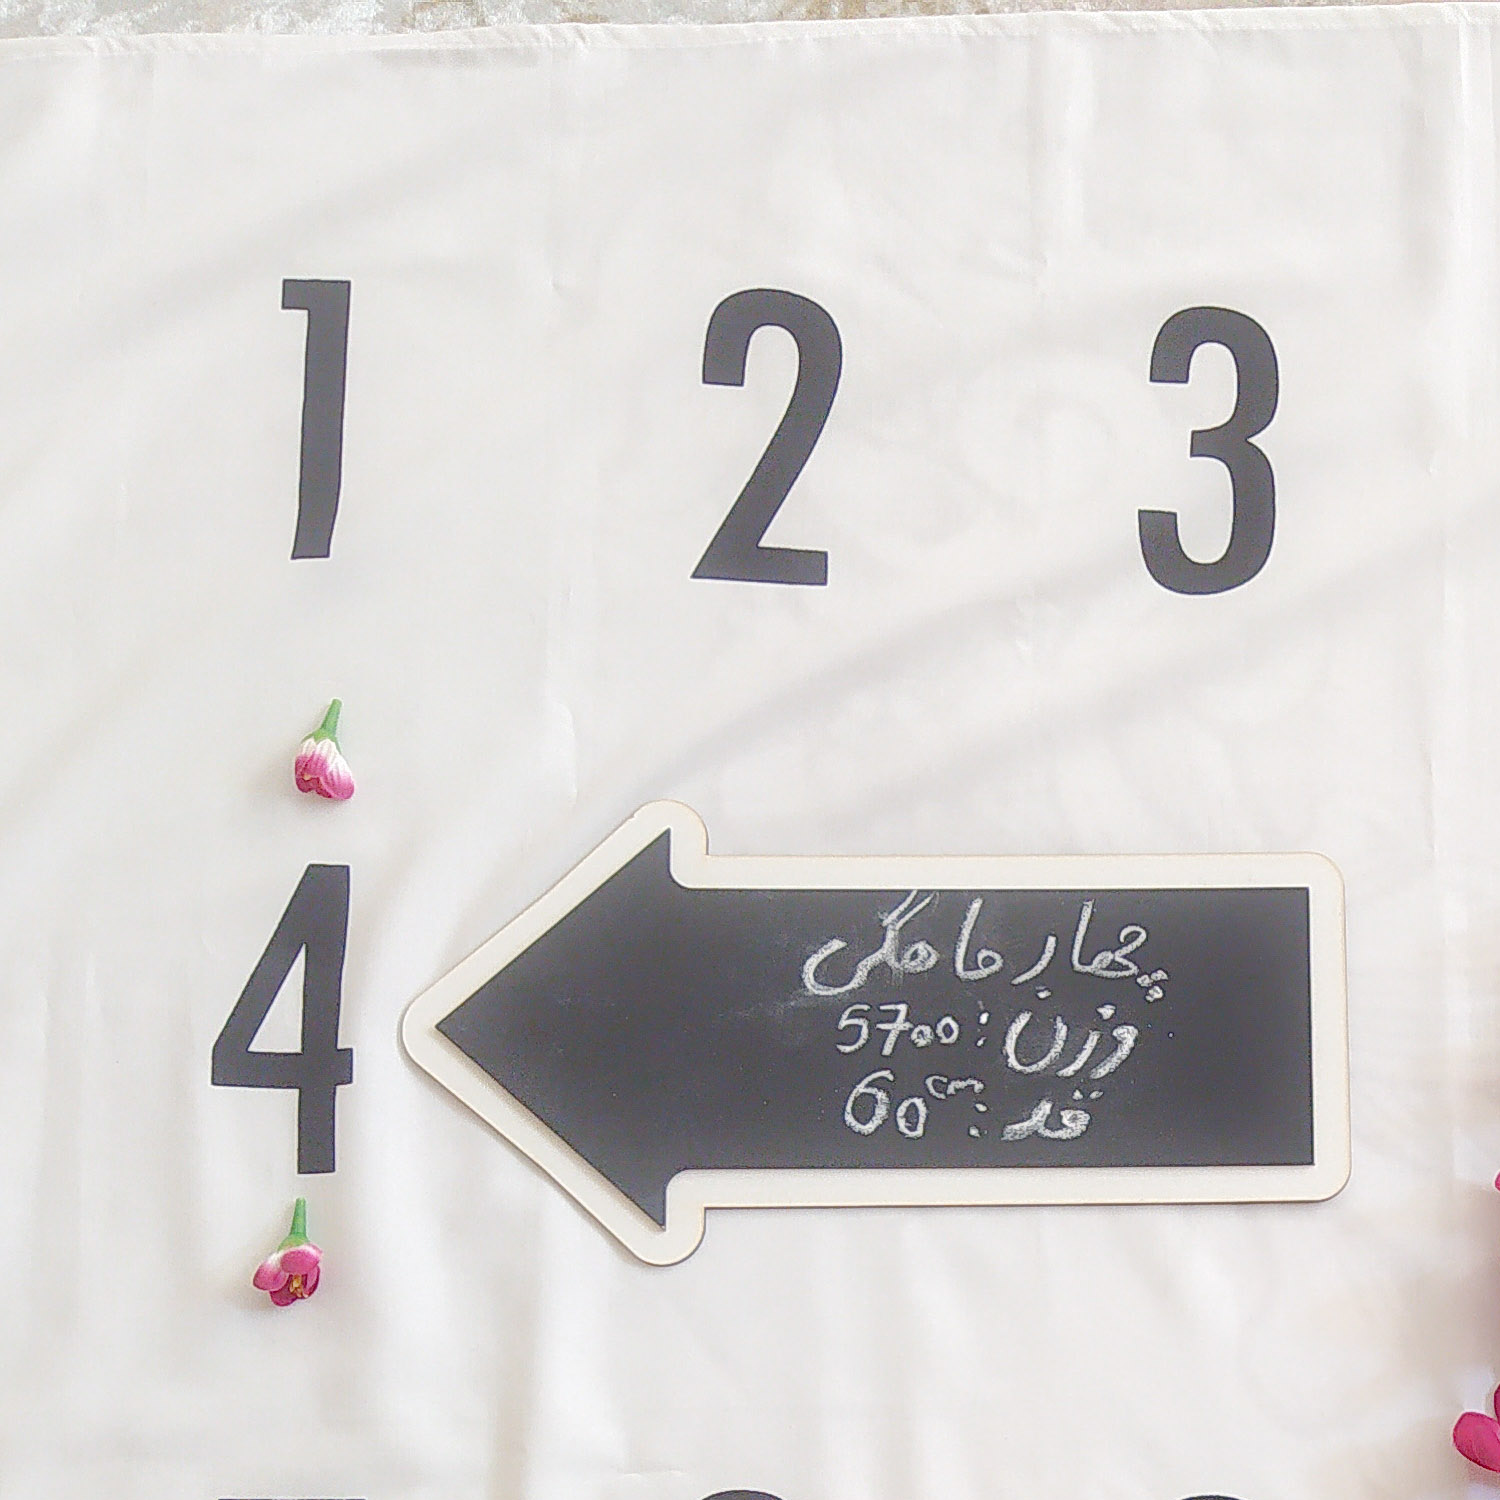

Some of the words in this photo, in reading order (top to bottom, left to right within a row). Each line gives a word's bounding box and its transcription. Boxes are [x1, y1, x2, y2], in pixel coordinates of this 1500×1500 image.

[281, 278, 352, 560] 1
[690, 288, 843, 586] 2
[1137, 306, 1280, 596] 3
[210, 863, 354, 1175] 4
